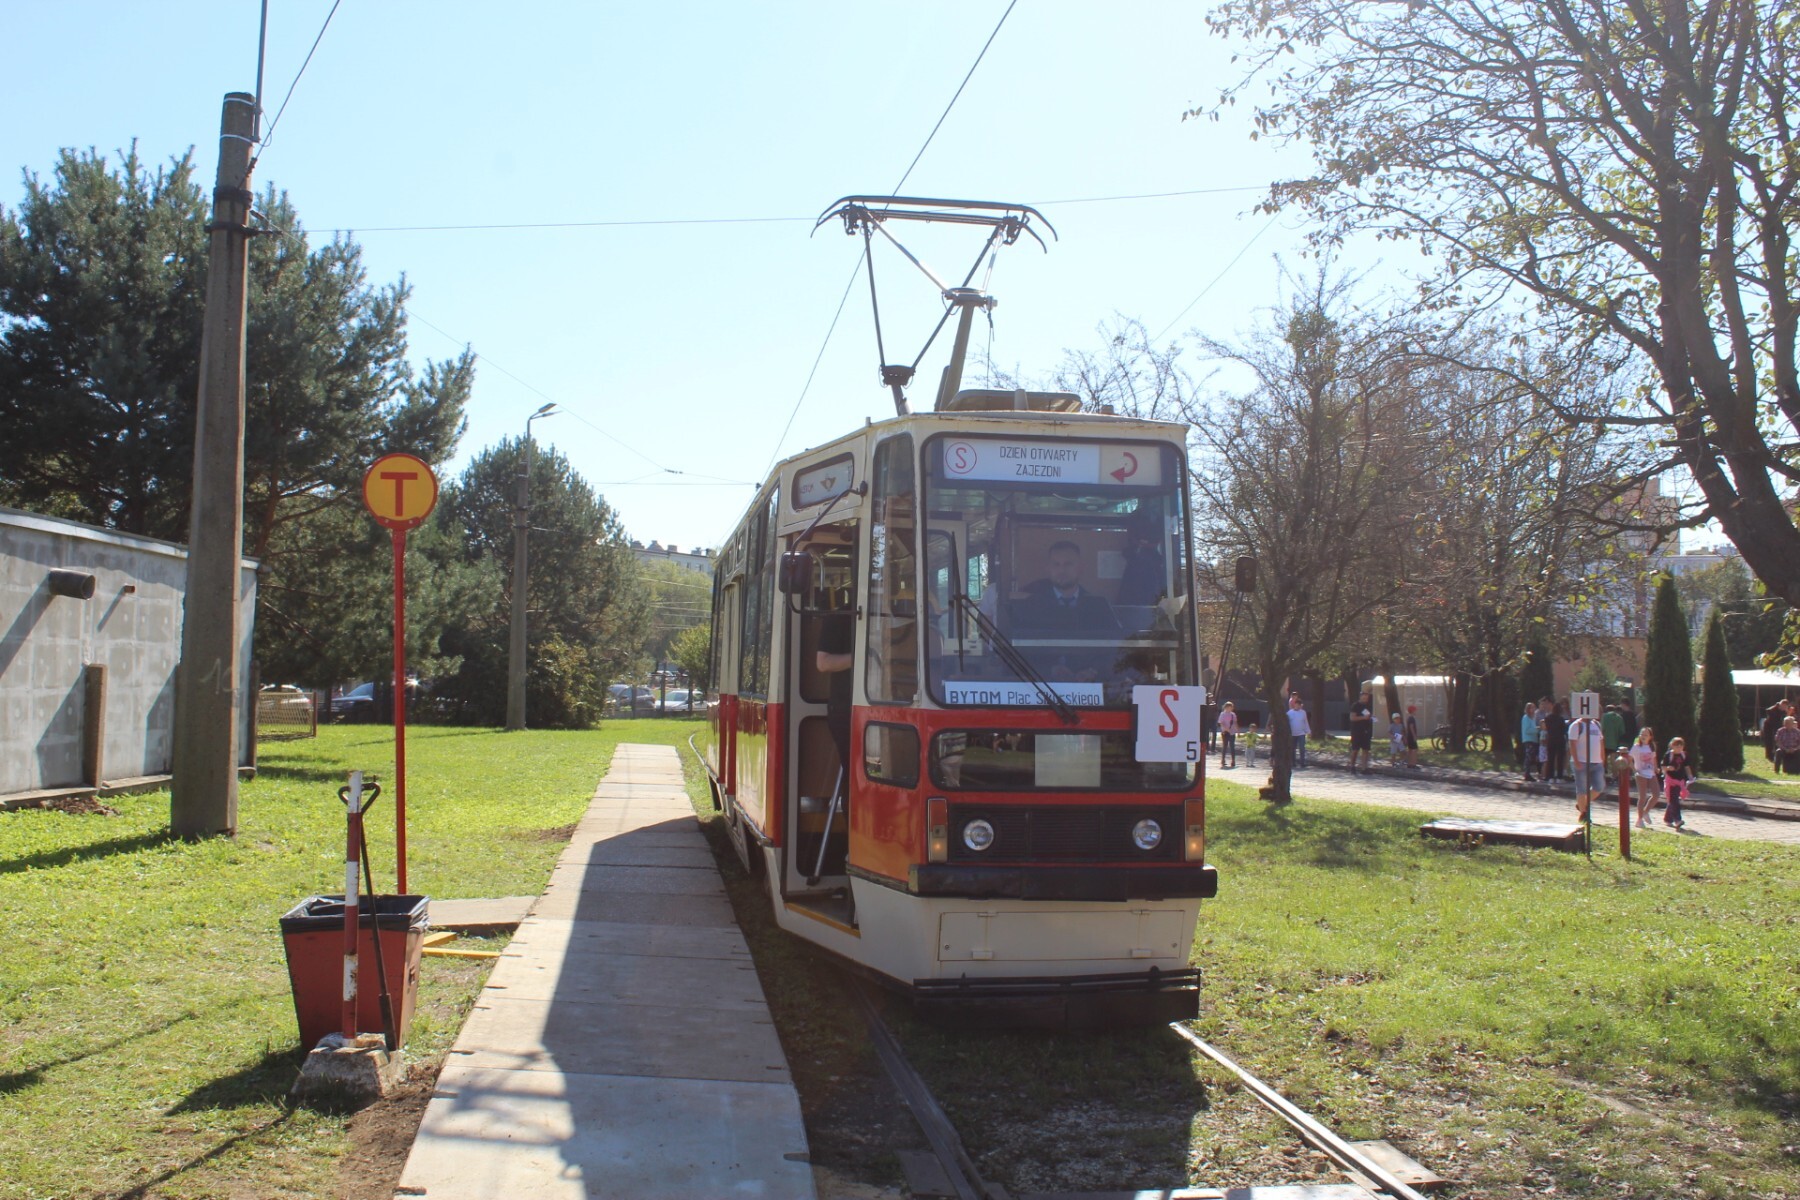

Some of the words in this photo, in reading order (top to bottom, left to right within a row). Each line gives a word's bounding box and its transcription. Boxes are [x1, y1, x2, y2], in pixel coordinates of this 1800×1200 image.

[955, 447, 967, 469] S
[1030, 448, 1078, 461] OTWARTY
[1015, 463, 1061, 477] ZAJEZDNI
[380, 471, 418, 517] T
[950, 690, 1001, 704] BYTOM
[1007, 691, 1031, 705] Plac
[1580, 696, 1590, 715] H
[1158, 689, 1179, 738] S
[1186, 741, 1197, 760] 5
